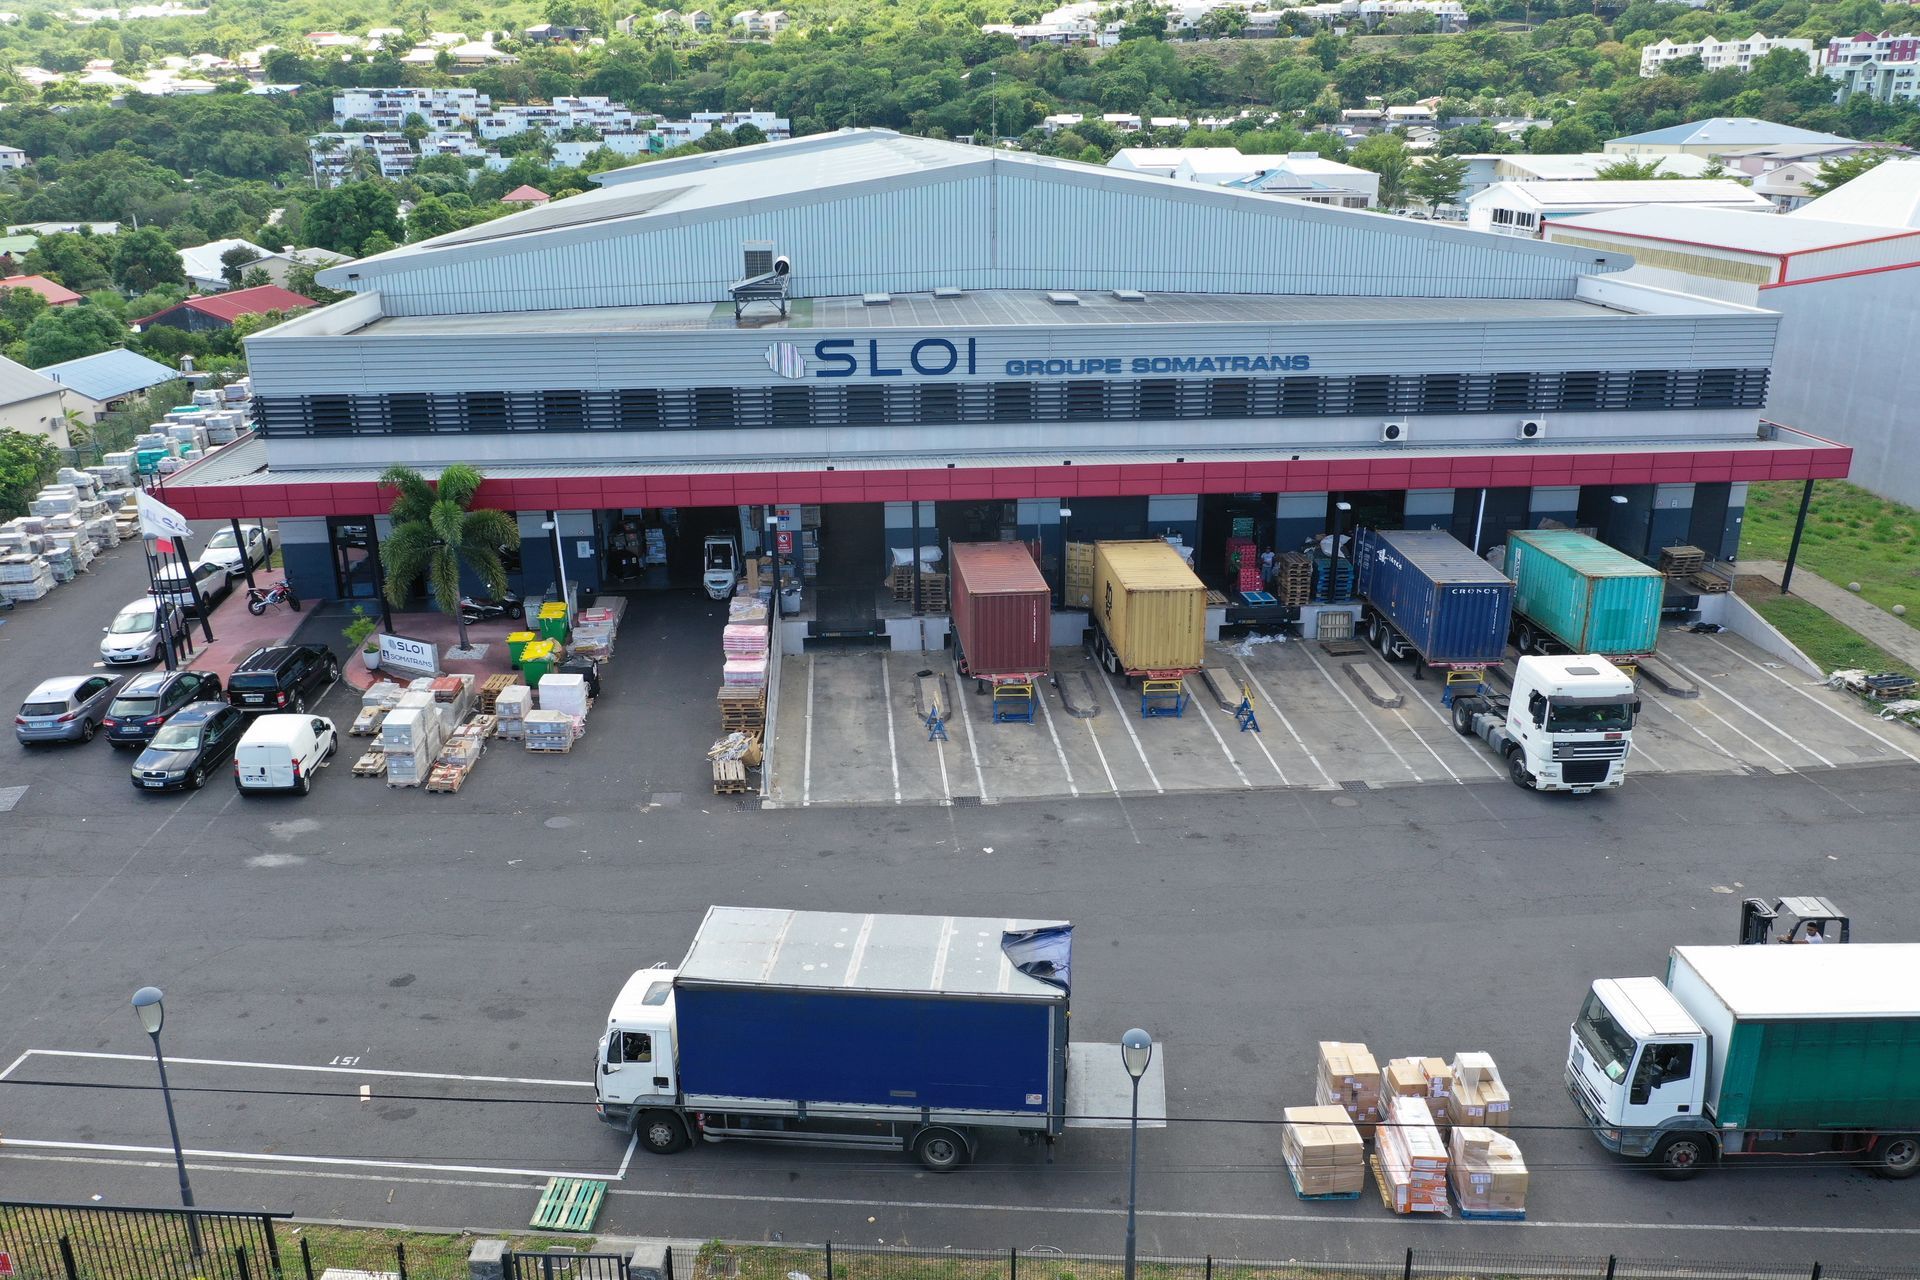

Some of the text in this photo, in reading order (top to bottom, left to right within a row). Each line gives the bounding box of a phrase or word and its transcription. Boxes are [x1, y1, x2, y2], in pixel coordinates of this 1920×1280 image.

[814, 337, 976, 378] SLOI
[1005, 354, 1310, 376] GROUPE SOMATRANS
[396, 641, 424, 654] SLOI
[390, 653, 433, 667] SOMATRANS
